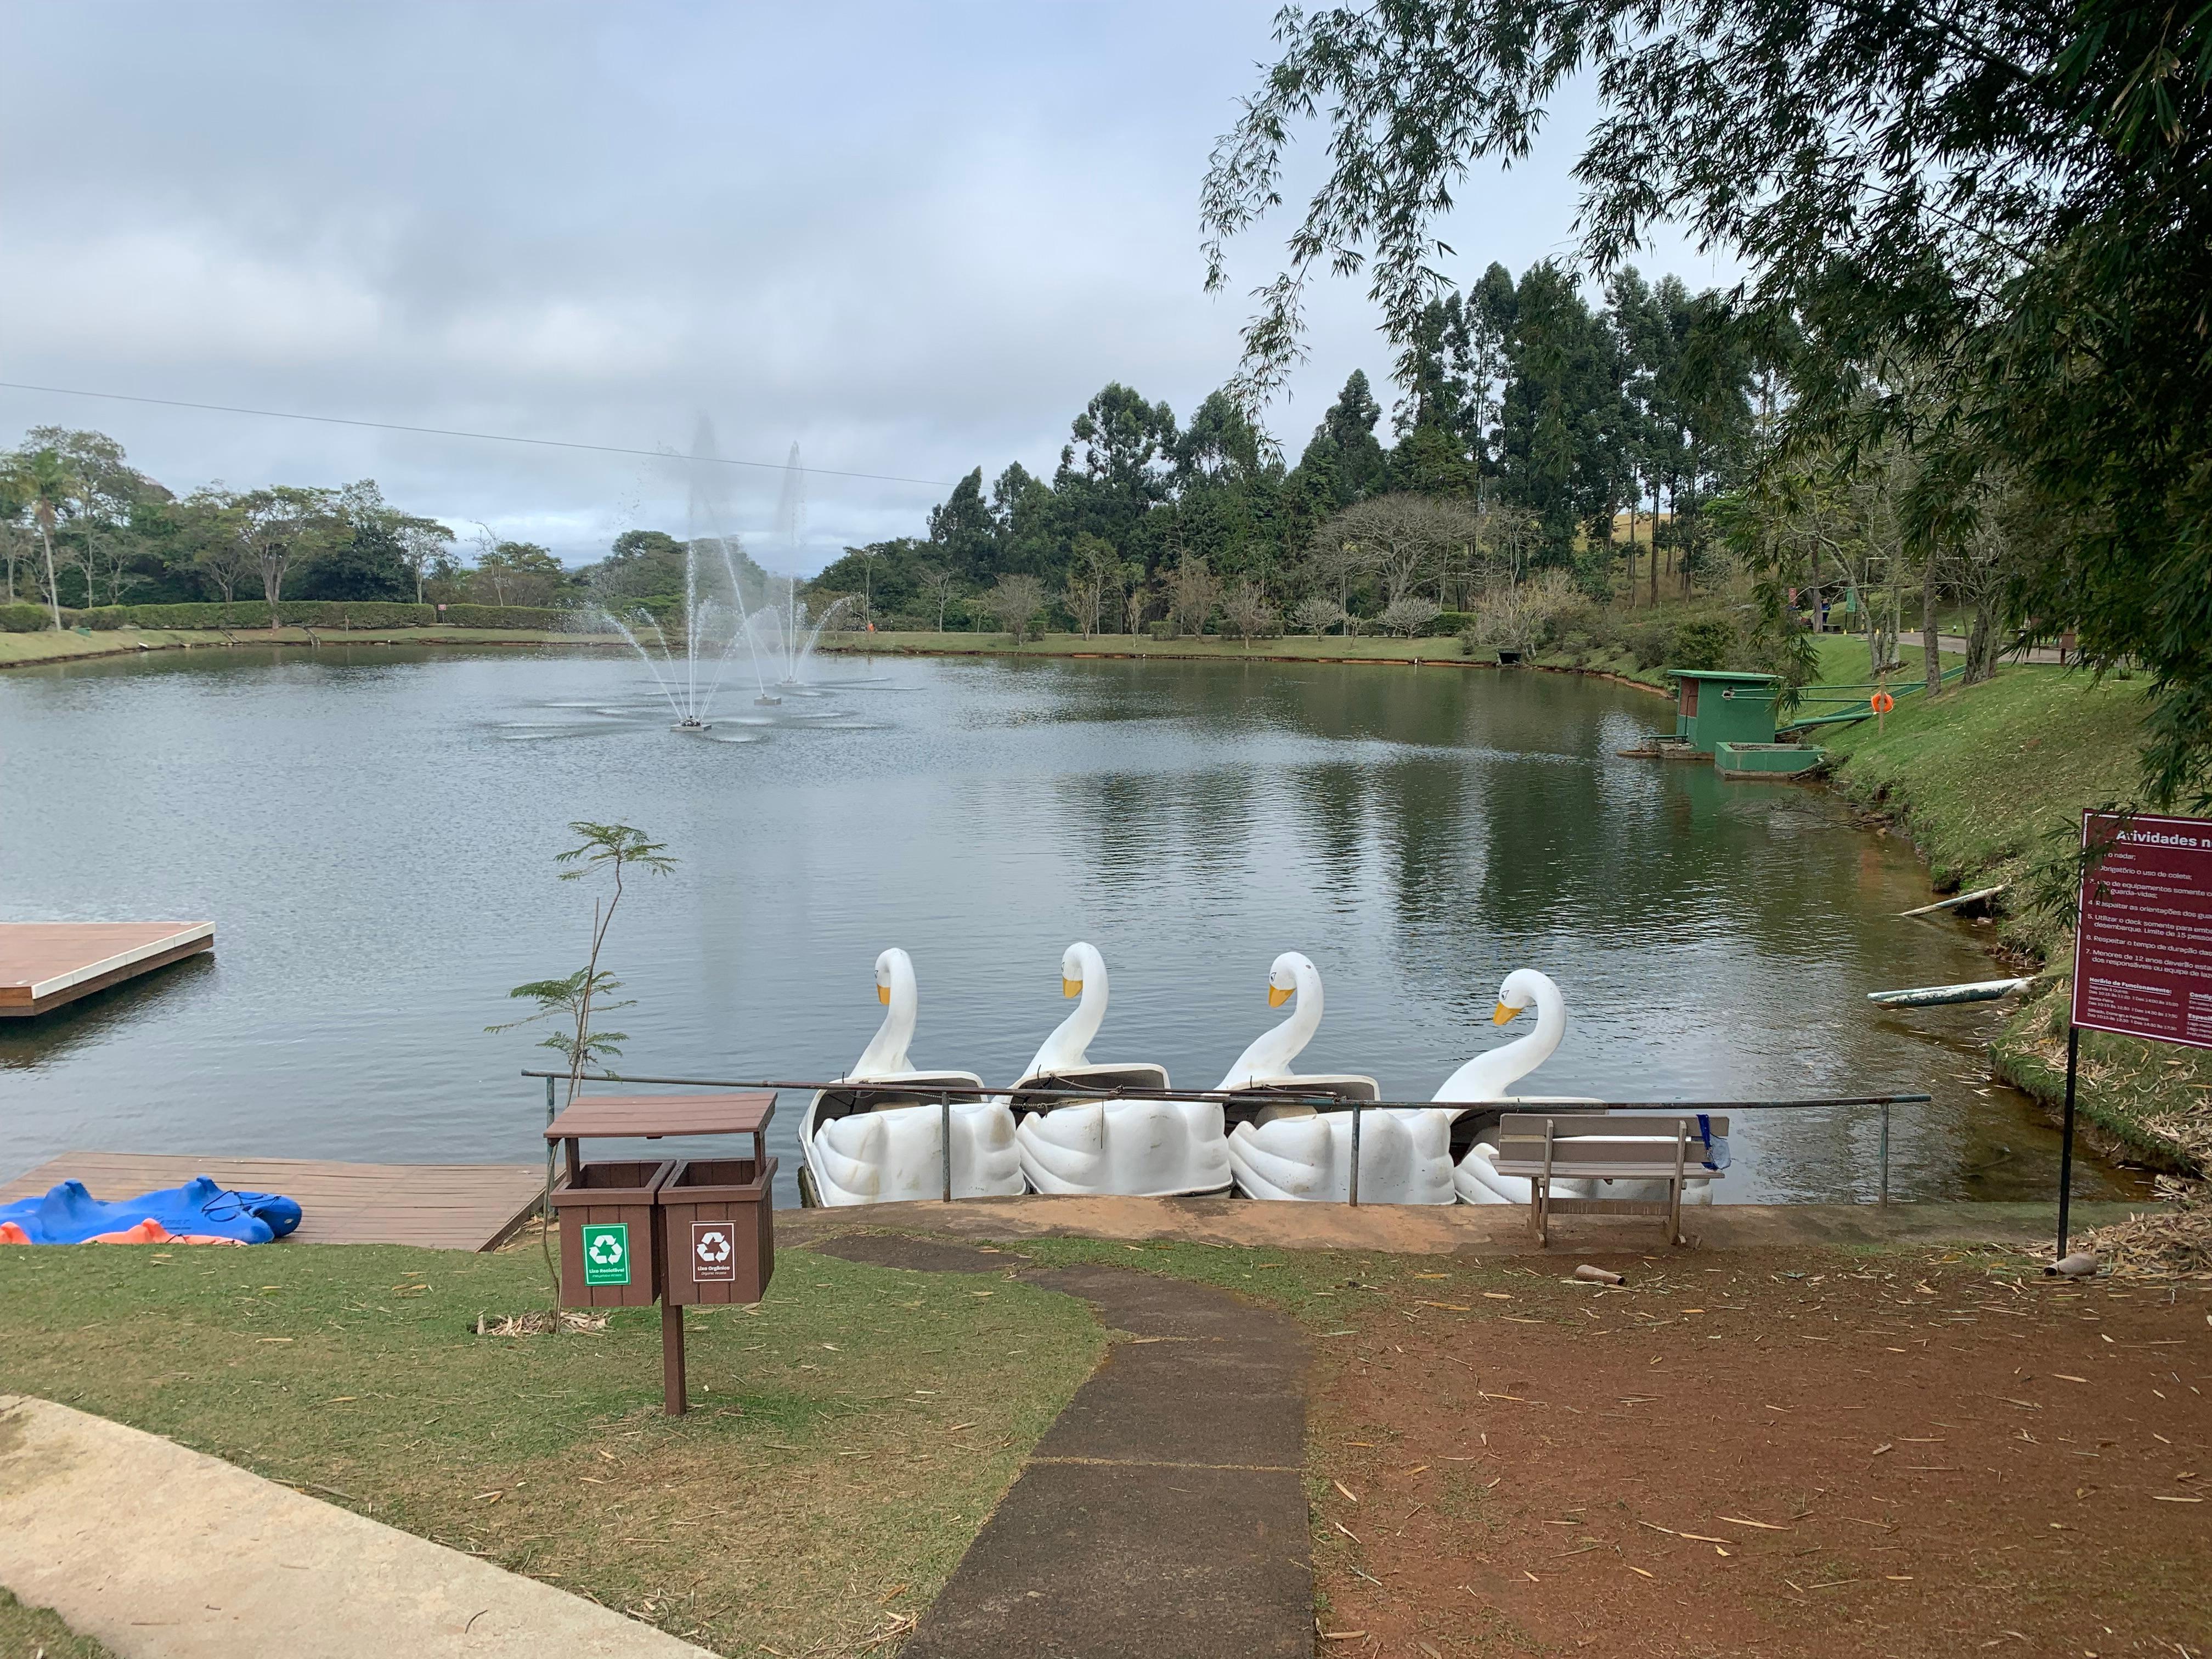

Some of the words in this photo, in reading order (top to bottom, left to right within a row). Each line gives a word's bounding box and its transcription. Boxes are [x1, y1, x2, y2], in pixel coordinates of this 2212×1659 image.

[2202, 839, 2212, 848] n
[2122, 882, 2172, 893] equipamentos
[2139, 906, 2182, 916] orientações
[2095, 915, 2118, 923] Utilizar
[2143, 921, 2175, 929] somente
[2094, 935, 2126, 945] Respeitar
[2134, 941, 2156, 949] tempo
[2168, 946, 2198, 954] duração
[2093, 950, 2123, 959] Menores
[2164, 960, 2194, 968] deverão
[2121, 981, 2172, 994] Funcionamento:
